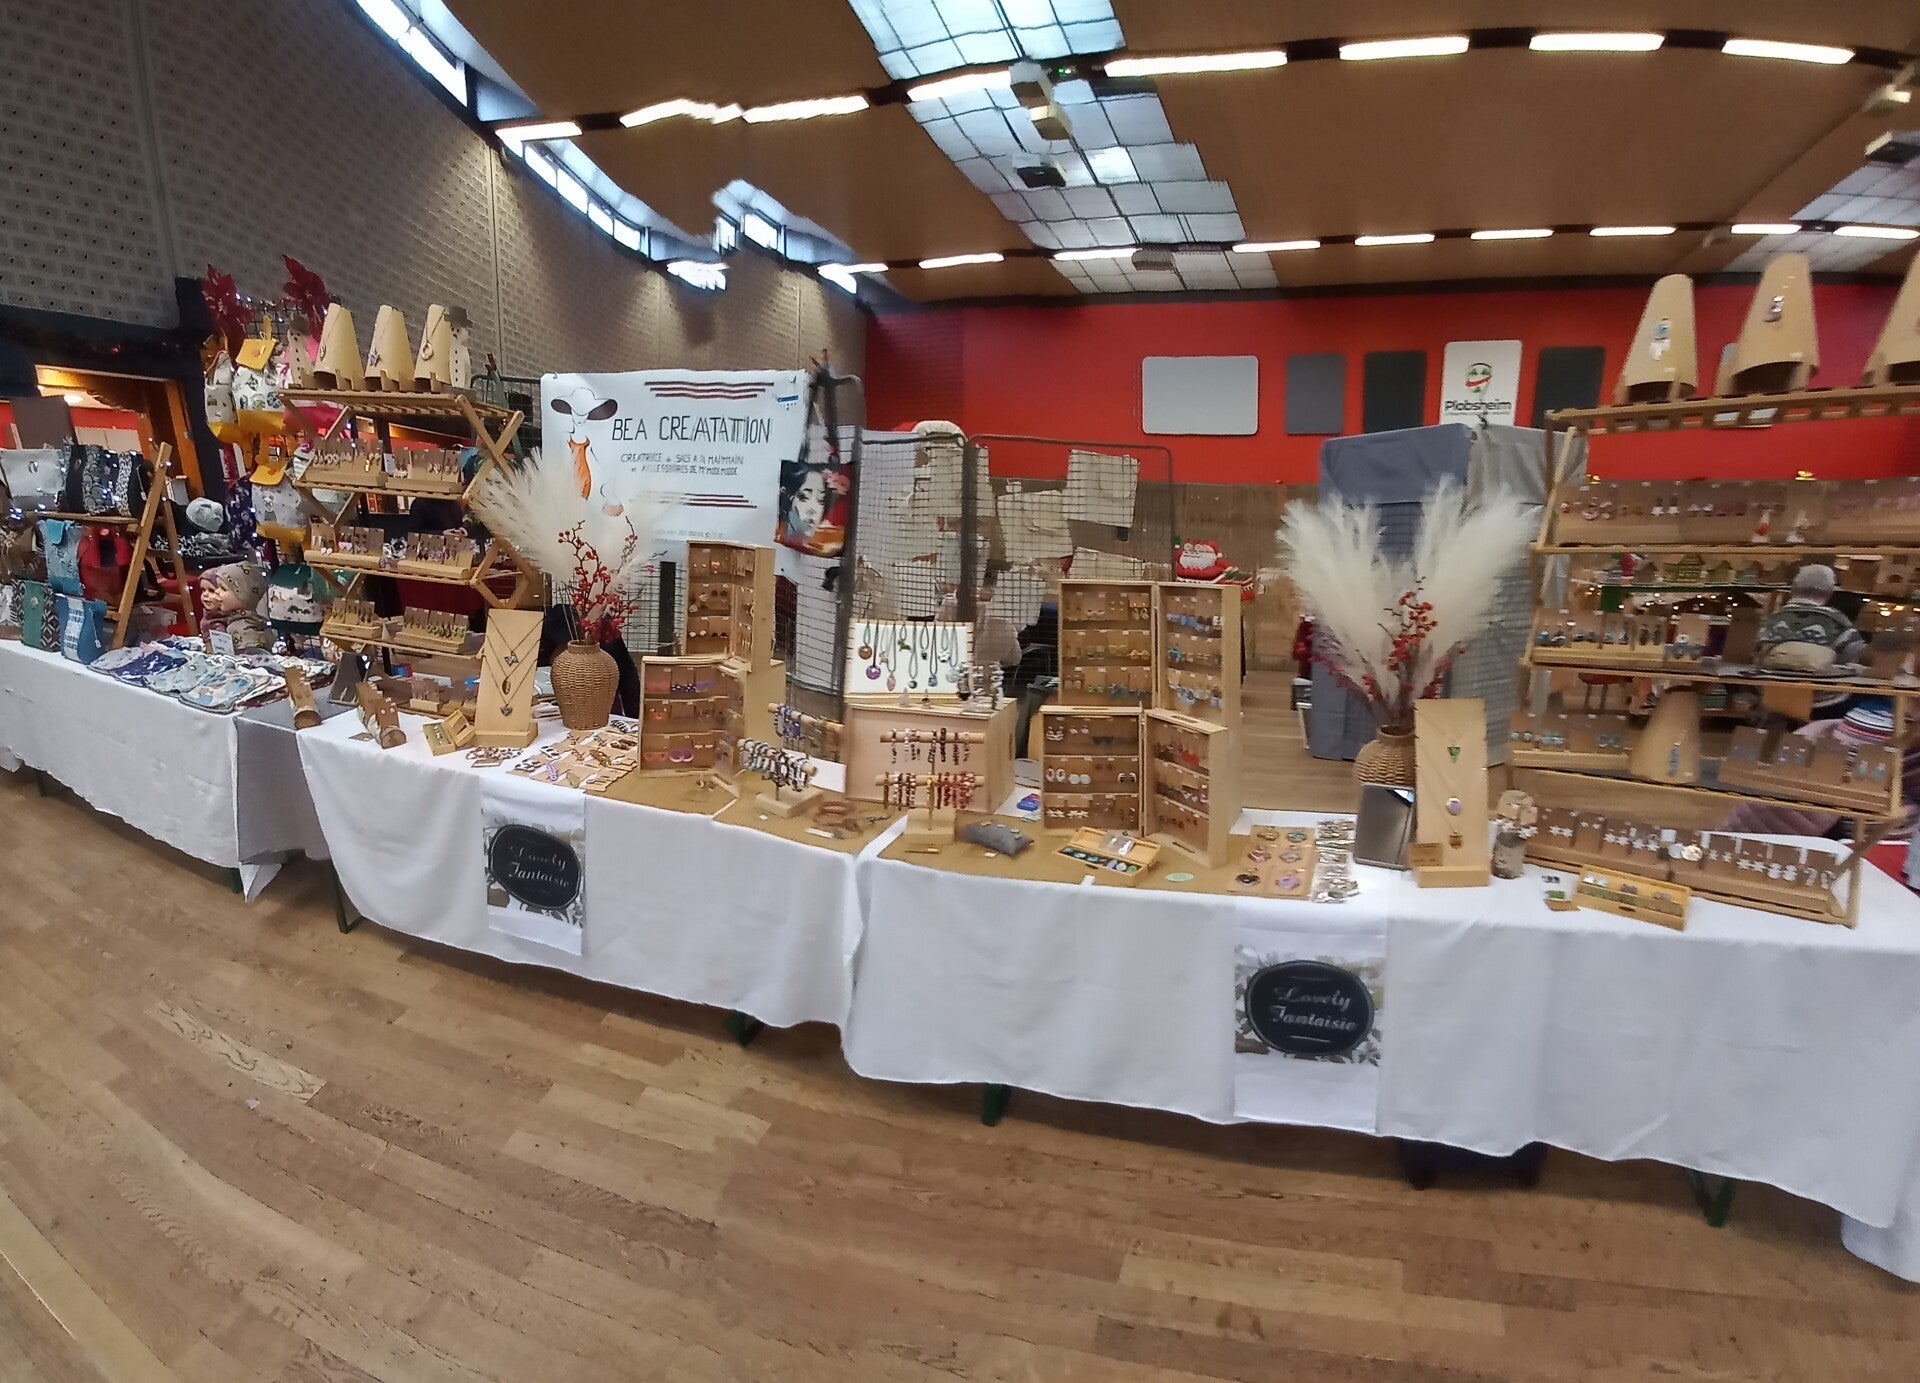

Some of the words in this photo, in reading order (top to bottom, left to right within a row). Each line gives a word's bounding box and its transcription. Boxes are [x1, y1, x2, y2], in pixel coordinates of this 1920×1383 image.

[612, 418, 648, 441] BEA
[1274, 987, 1351, 1013] Lovely
[1271, 1005, 1358, 1032] Fantaisie
